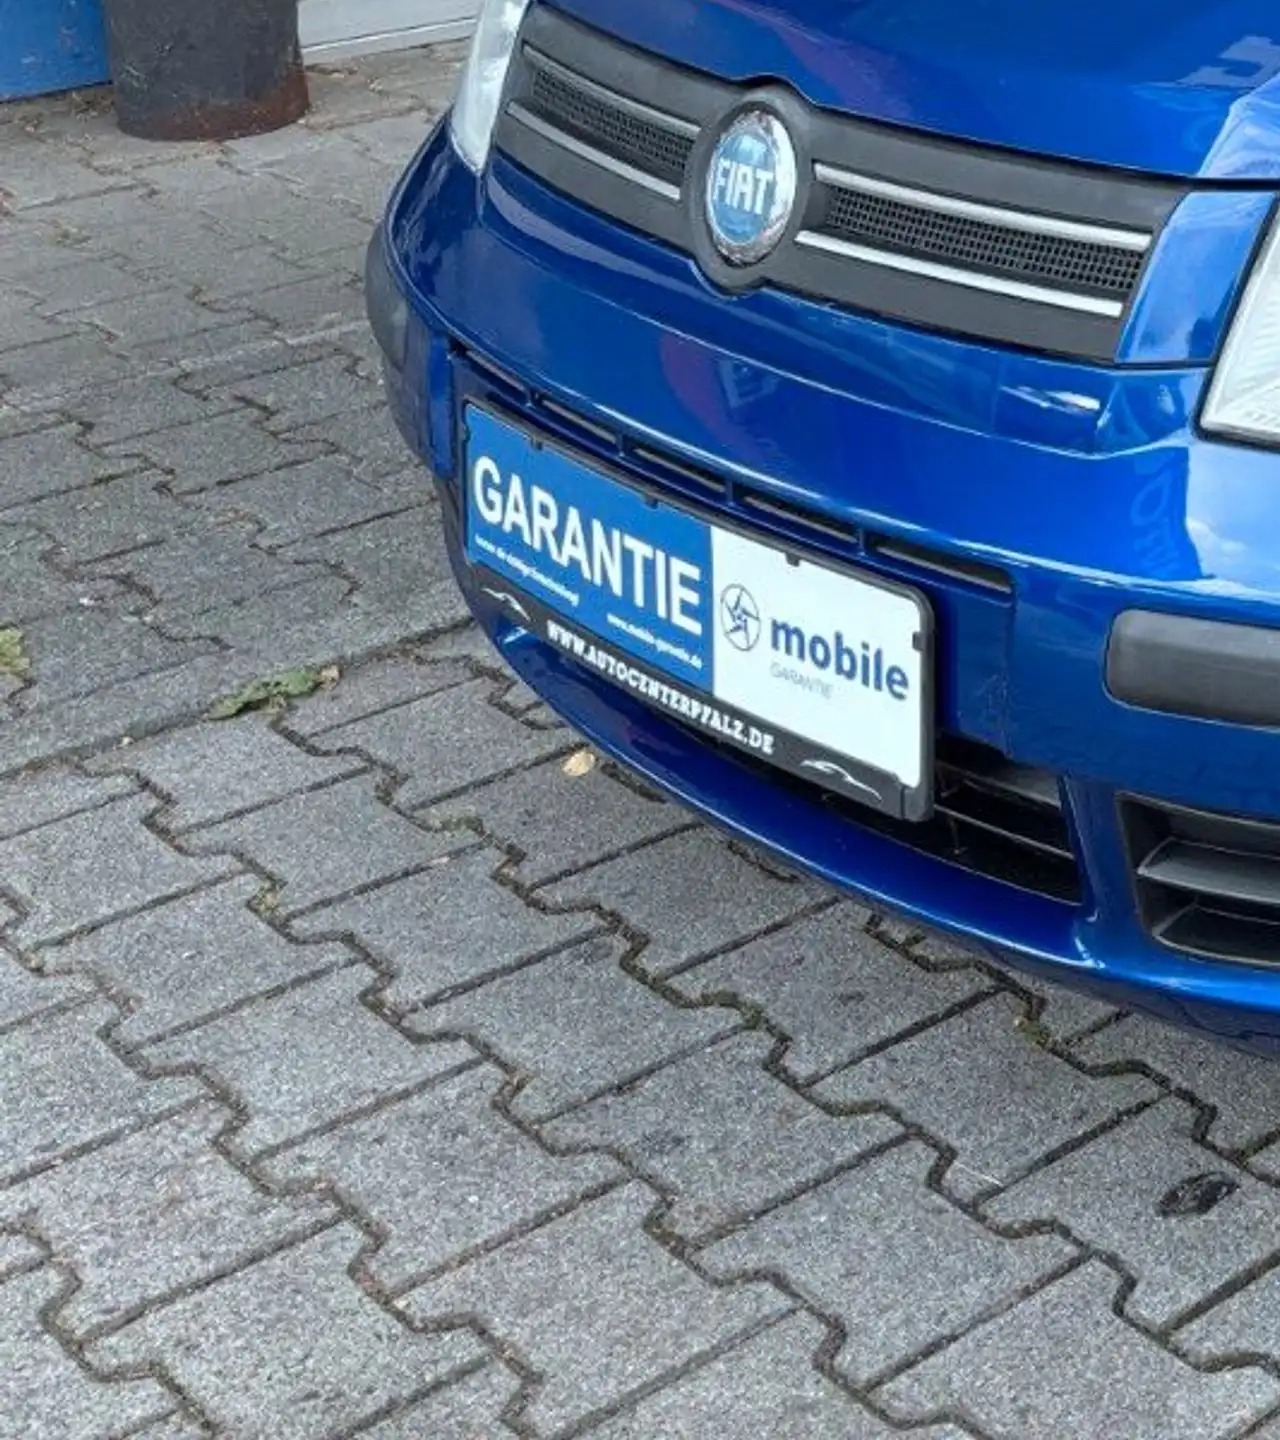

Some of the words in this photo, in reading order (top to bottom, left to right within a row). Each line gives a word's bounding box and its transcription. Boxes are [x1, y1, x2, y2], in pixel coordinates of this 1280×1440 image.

[714, 157, 774, 215] FIAT
[473, 455, 703, 635] GARANTIE
[771, 618, 910, 702] mobile
